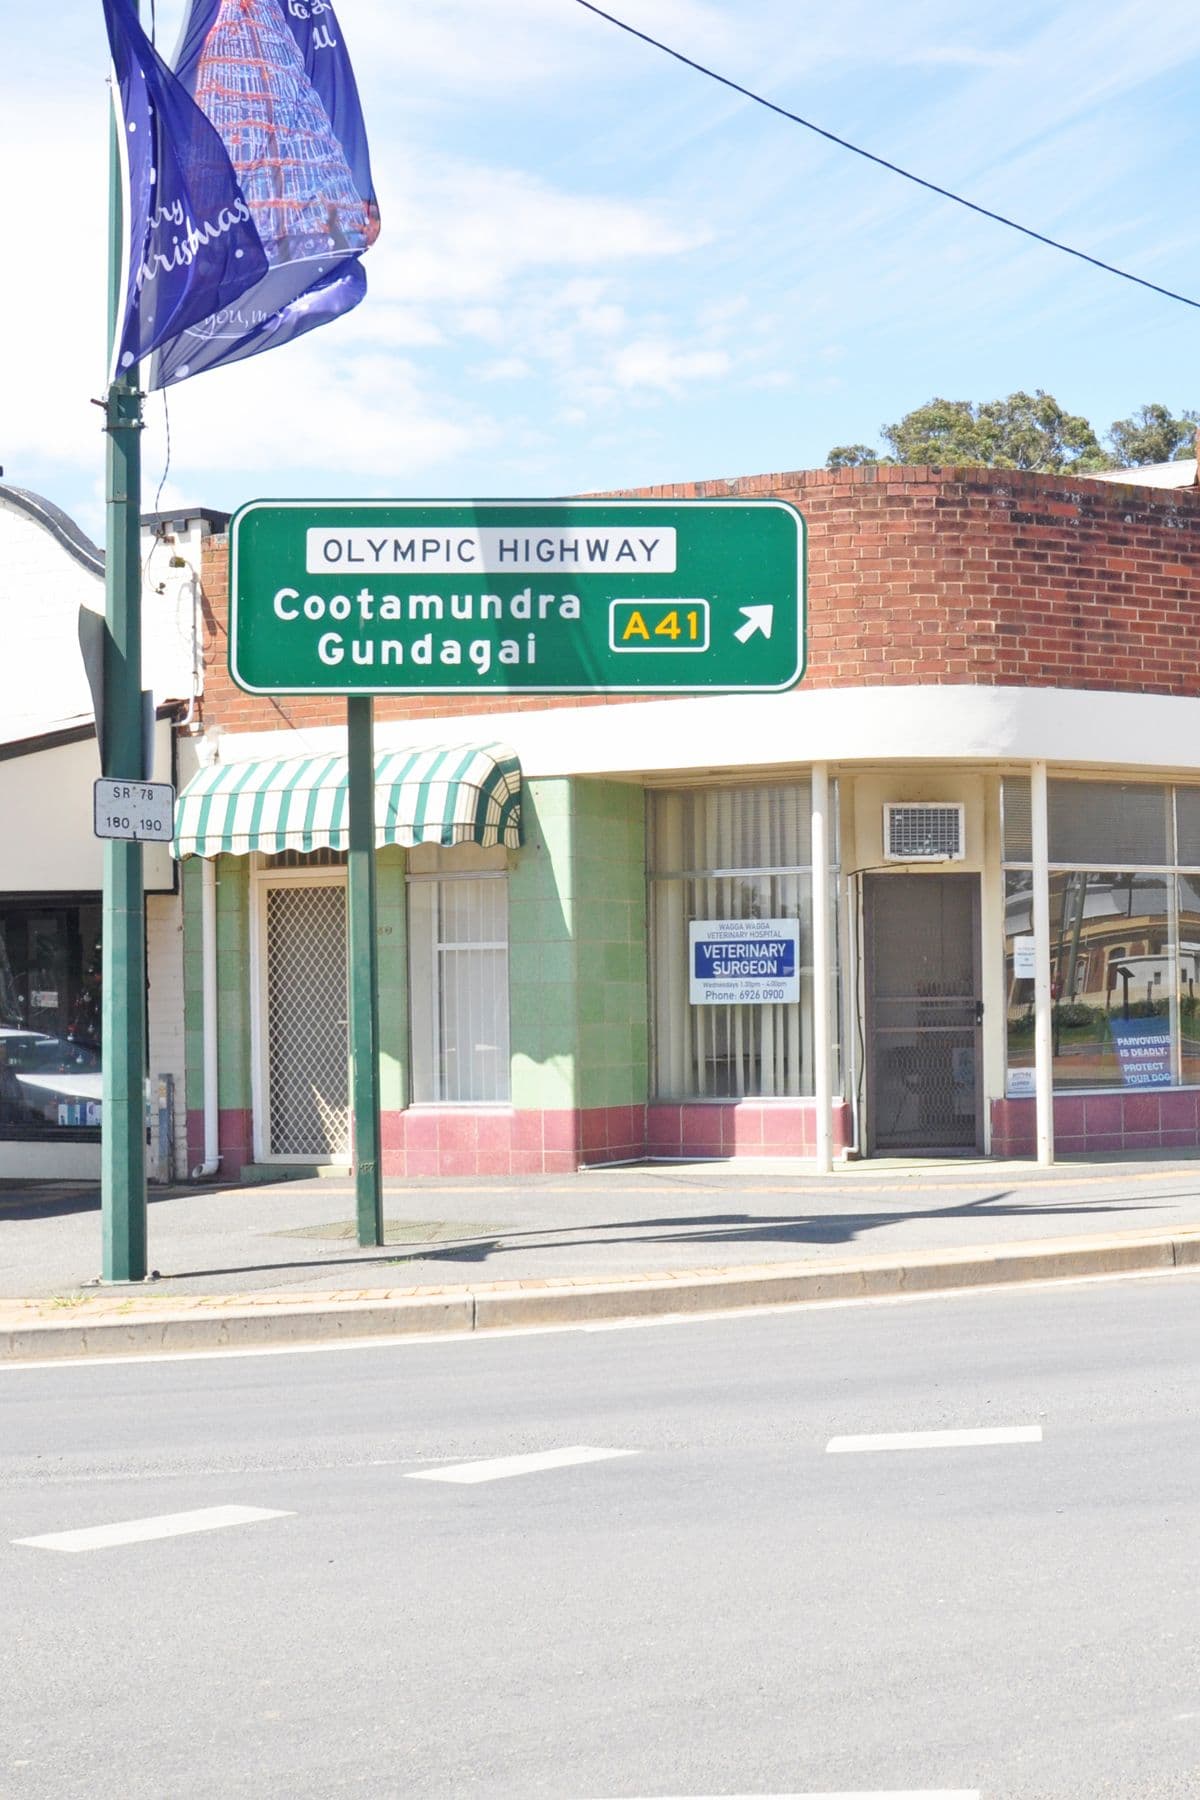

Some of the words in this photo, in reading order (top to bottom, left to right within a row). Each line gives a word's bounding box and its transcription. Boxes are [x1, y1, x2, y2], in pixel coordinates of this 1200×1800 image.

[323, 539, 476, 562] OLYMPIC
[498, 539, 660, 562] HIGHWAY
[273, 587, 581, 620] Cootamundra
[622, 611, 698, 640] A41
[318, 632, 536, 675] Gundagai
[113, 787, 130, 798] SR
[141, 789, 153, 800] 78
[107, 817, 130, 829] 180
[140, 820, 162, 831] 190
[707, 931, 748, 939] VETERINARY
[703, 943, 786, 959] VETERINARY
[713, 960, 777, 975] SURGEON
[705, 990, 737, 1000] Phone:
[740, 990, 760, 999] 6926
[763, 989, 784, 999] 0900
